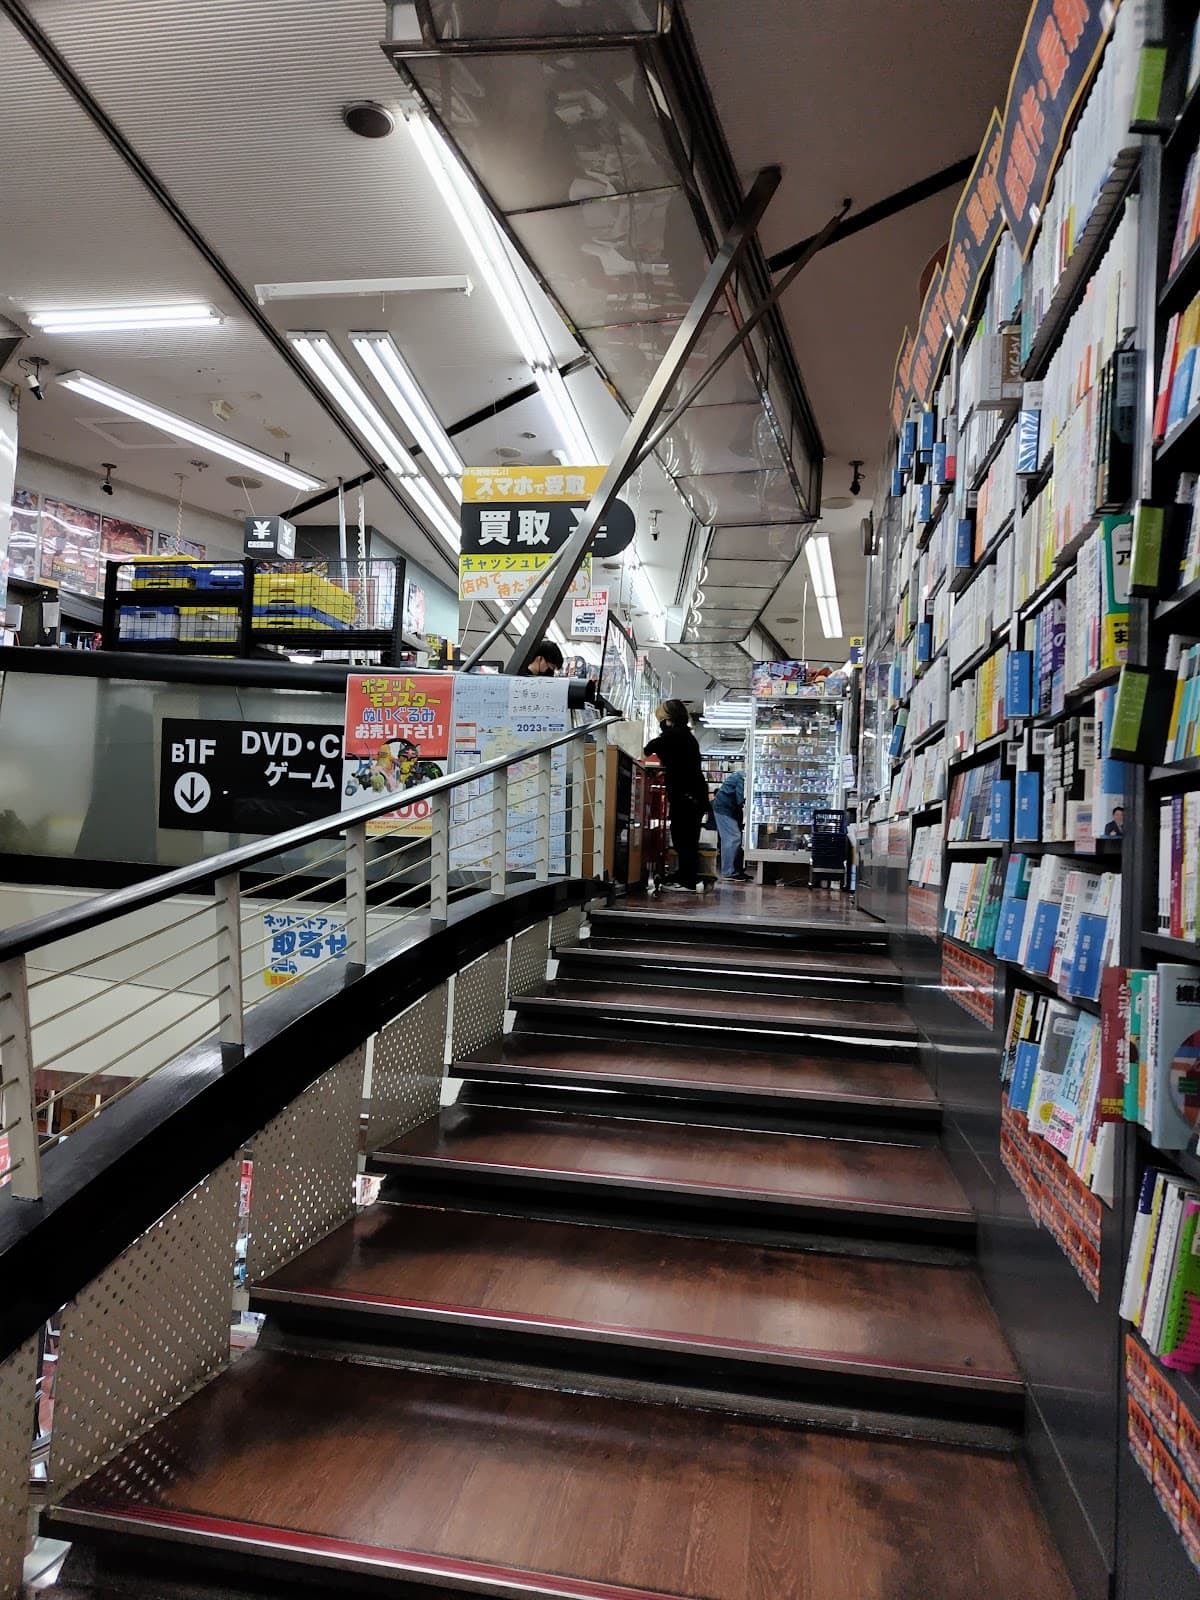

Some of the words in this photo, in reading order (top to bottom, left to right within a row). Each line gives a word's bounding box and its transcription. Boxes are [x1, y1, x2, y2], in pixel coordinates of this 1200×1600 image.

[475, 475, 585, 496] スマホで受取
[478, 510, 551, 546] 買取
[361, 678, 417, 694] ポケット
[370, 692, 441, 708] モンスター
[363, 707, 436, 723] ぬいぐるみ
[355, 723, 443, 739] お売り下さい
[171, 738, 217, 765] B1F
[241, 730, 345, 759] DVD・C
[264, 761, 335, 790] ゲーム
[264, 913, 328, 930] ネットストア
